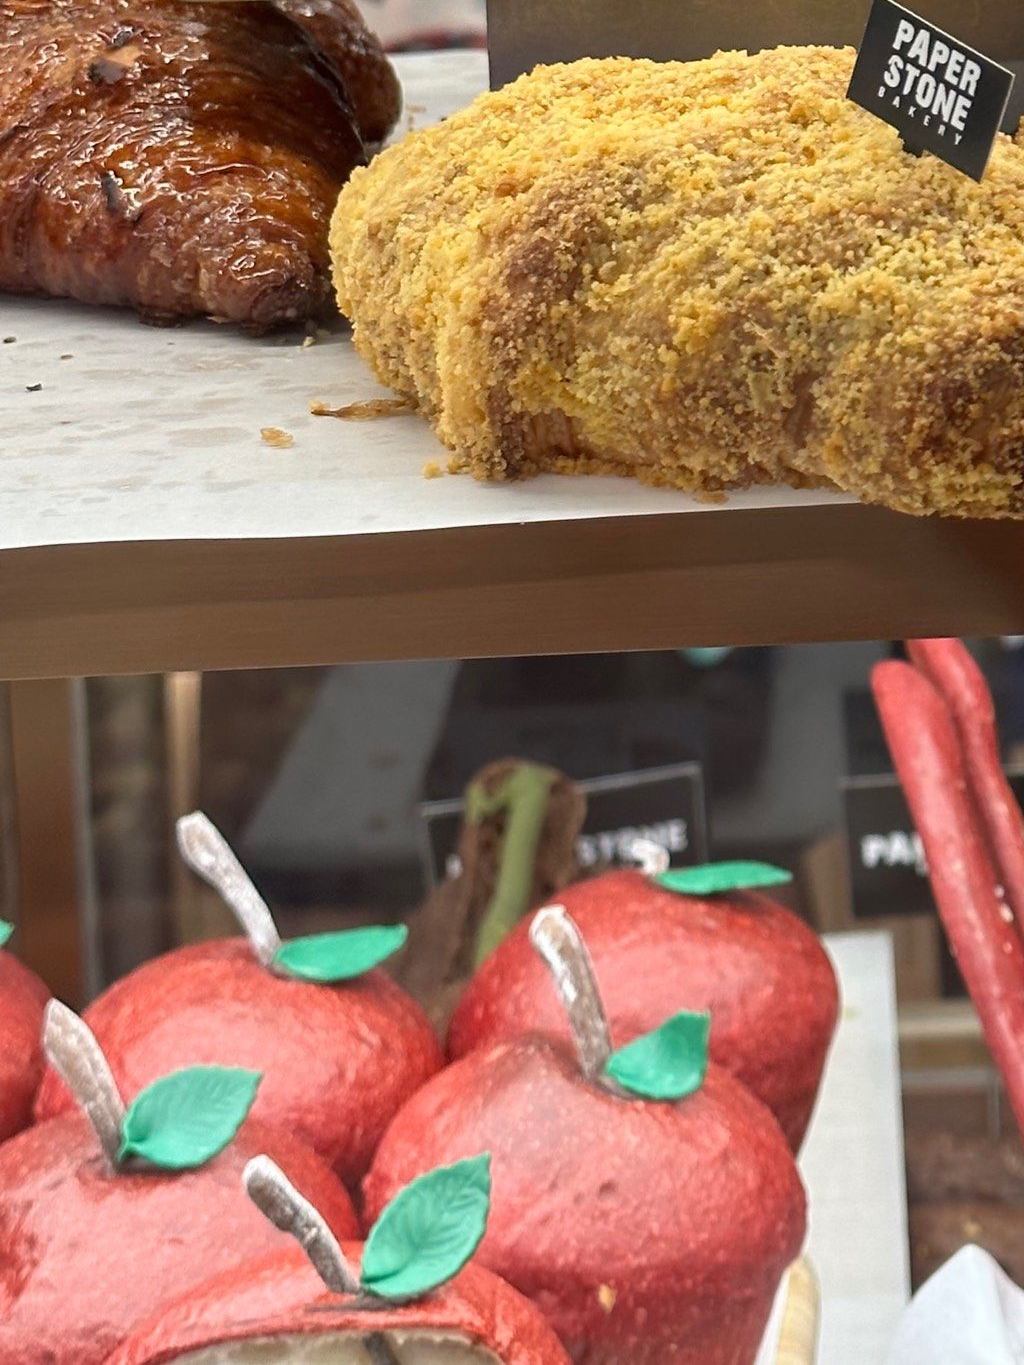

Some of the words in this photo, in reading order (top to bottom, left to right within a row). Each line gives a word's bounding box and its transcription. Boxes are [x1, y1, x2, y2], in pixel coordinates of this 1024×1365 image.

[884, 54, 972, 131] STONE
[892, 19, 982, 97] PAPER
[877, 86, 962, 146] BAKERY
